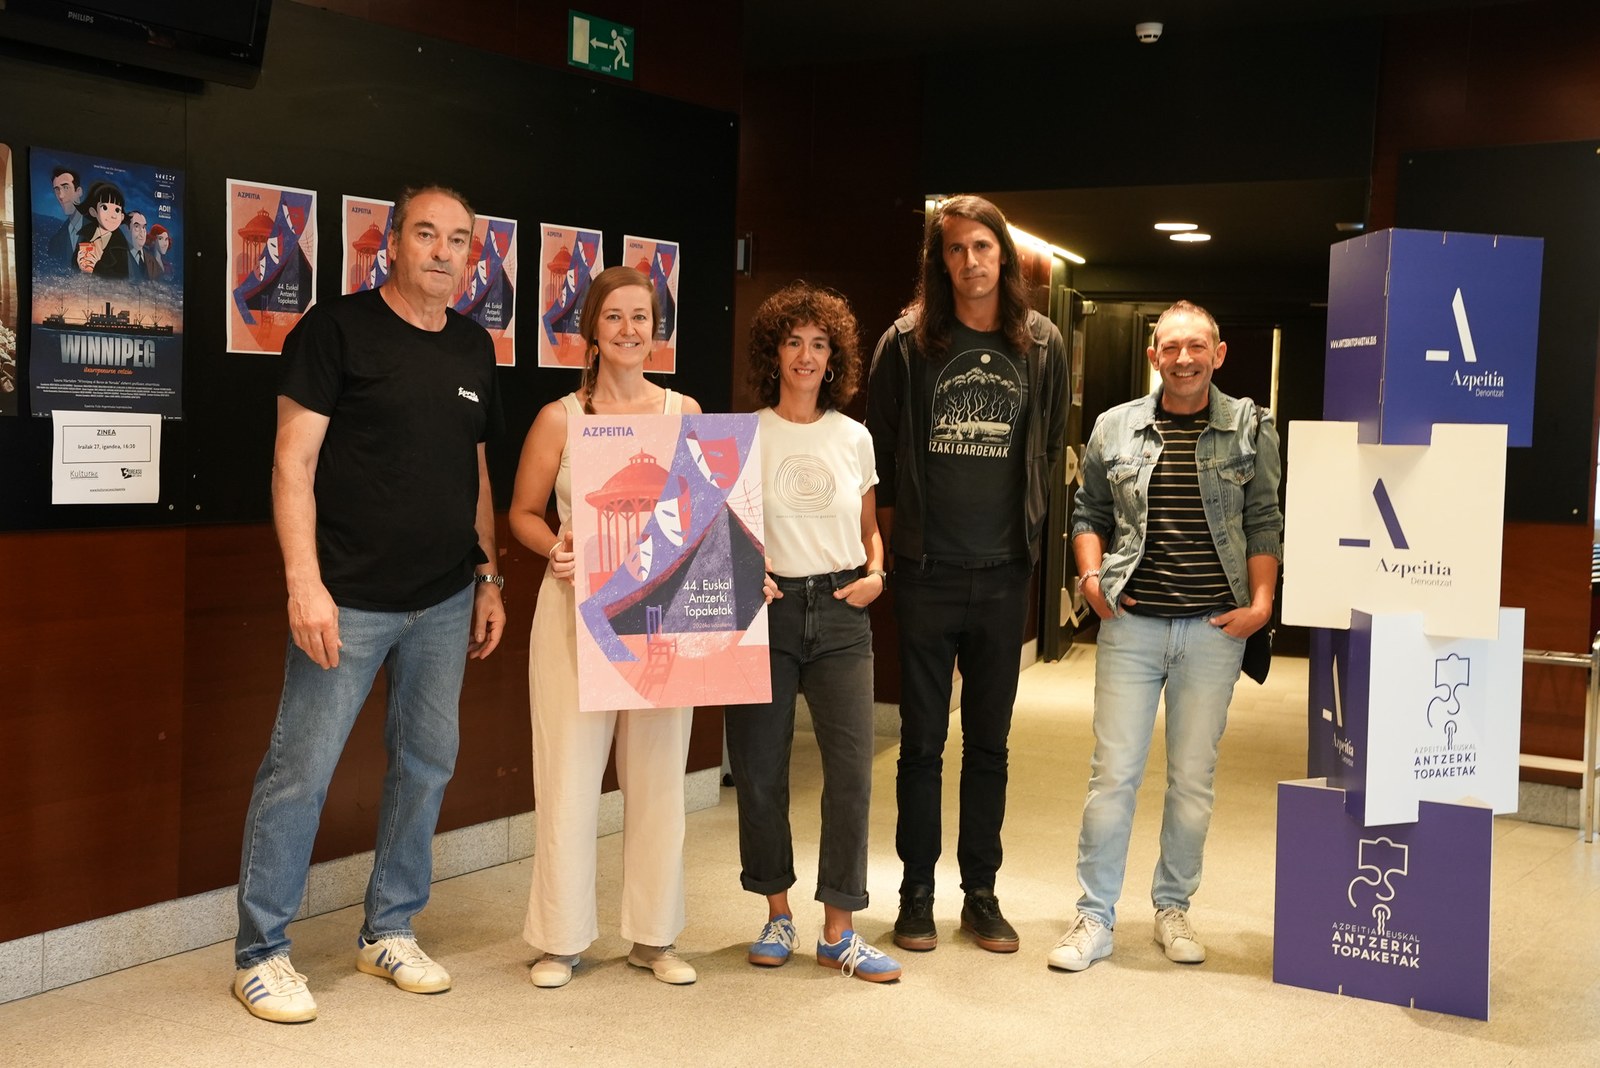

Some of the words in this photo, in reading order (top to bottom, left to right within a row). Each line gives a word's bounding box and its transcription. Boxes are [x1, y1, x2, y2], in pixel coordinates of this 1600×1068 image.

[68, 11, 94, 23] PHILIPS
[238, 191, 261, 200] AZPEITIA
[286, 283, 299, 291] Euskal
[60, 333, 156, 368] WINNIPEG
[1451, 369, 1504, 391] Azpeitia
[1475, 388, 1504, 397] Denontzat
[582, 426, 634, 437] AZPEITIA
[929, 441, 954, 454] IZAKI
[956, 443, 1009, 458] GARDENAK
[1376, 558, 1451, 578] Azpeitia
[683, 580, 699, 591] 44.
[702, 577, 732, 591] Euskal
[1411, 577, 1452, 587] Denontzat
[689, 591, 727, 603] Antzerki
[684, 604, 733, 619] Topaketak
[1414, 745, 1446, 754] AZPEITIA
[1453, 743, 1476, 751] EUSKAL
[1414, 752, 1476, 766] ANTZERKI
[1414, 765, 1476, 780] TOPAKETAK
[1332, 922, 1377, 935] AZPEITIA
[1386, 930, 1420, 942] EUSKAL
[1332, 931, 1420, 955] ANTZERKI
[1332, 943, 1420, 968] TOPAKETAK
